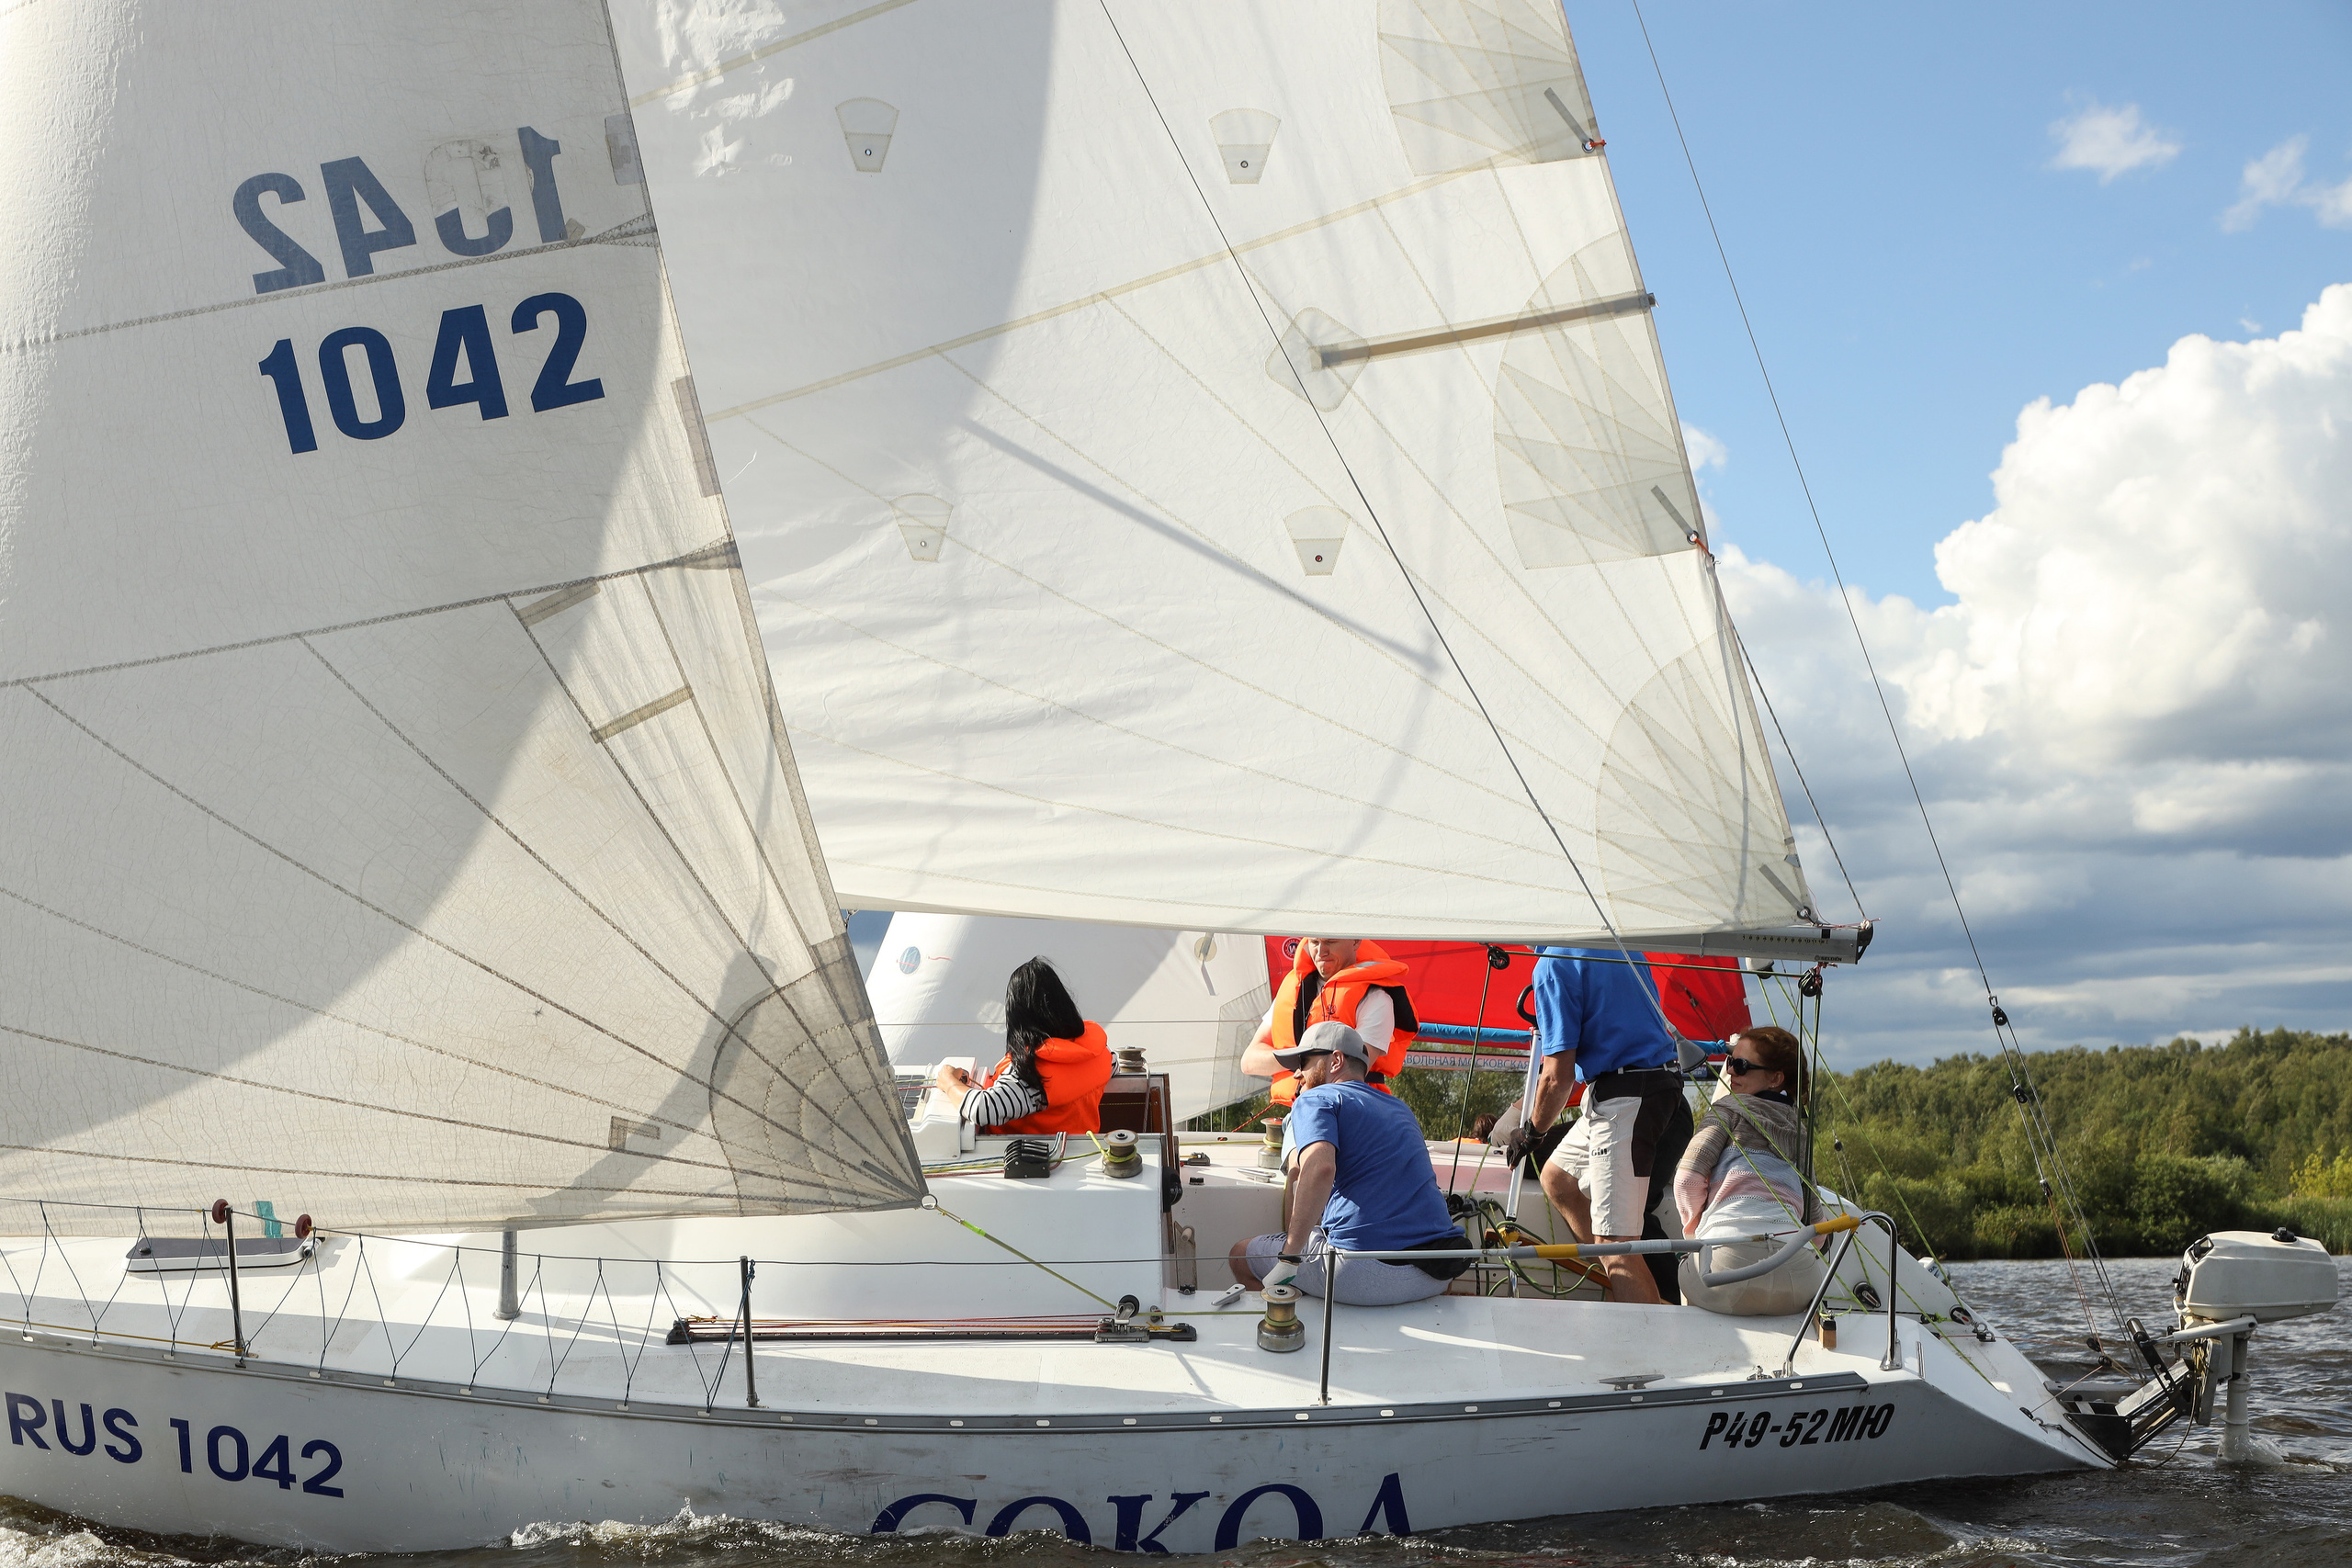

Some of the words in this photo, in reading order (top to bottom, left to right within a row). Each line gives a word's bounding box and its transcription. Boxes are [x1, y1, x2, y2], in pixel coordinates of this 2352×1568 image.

[258, 292, 605, 455] 1042
[1458, 1056, 1530, 1070] МОСКОВСКАЯ
[5, 1392, 142, 1464] RUS
[169, 1417, 345, 1498] 1042
